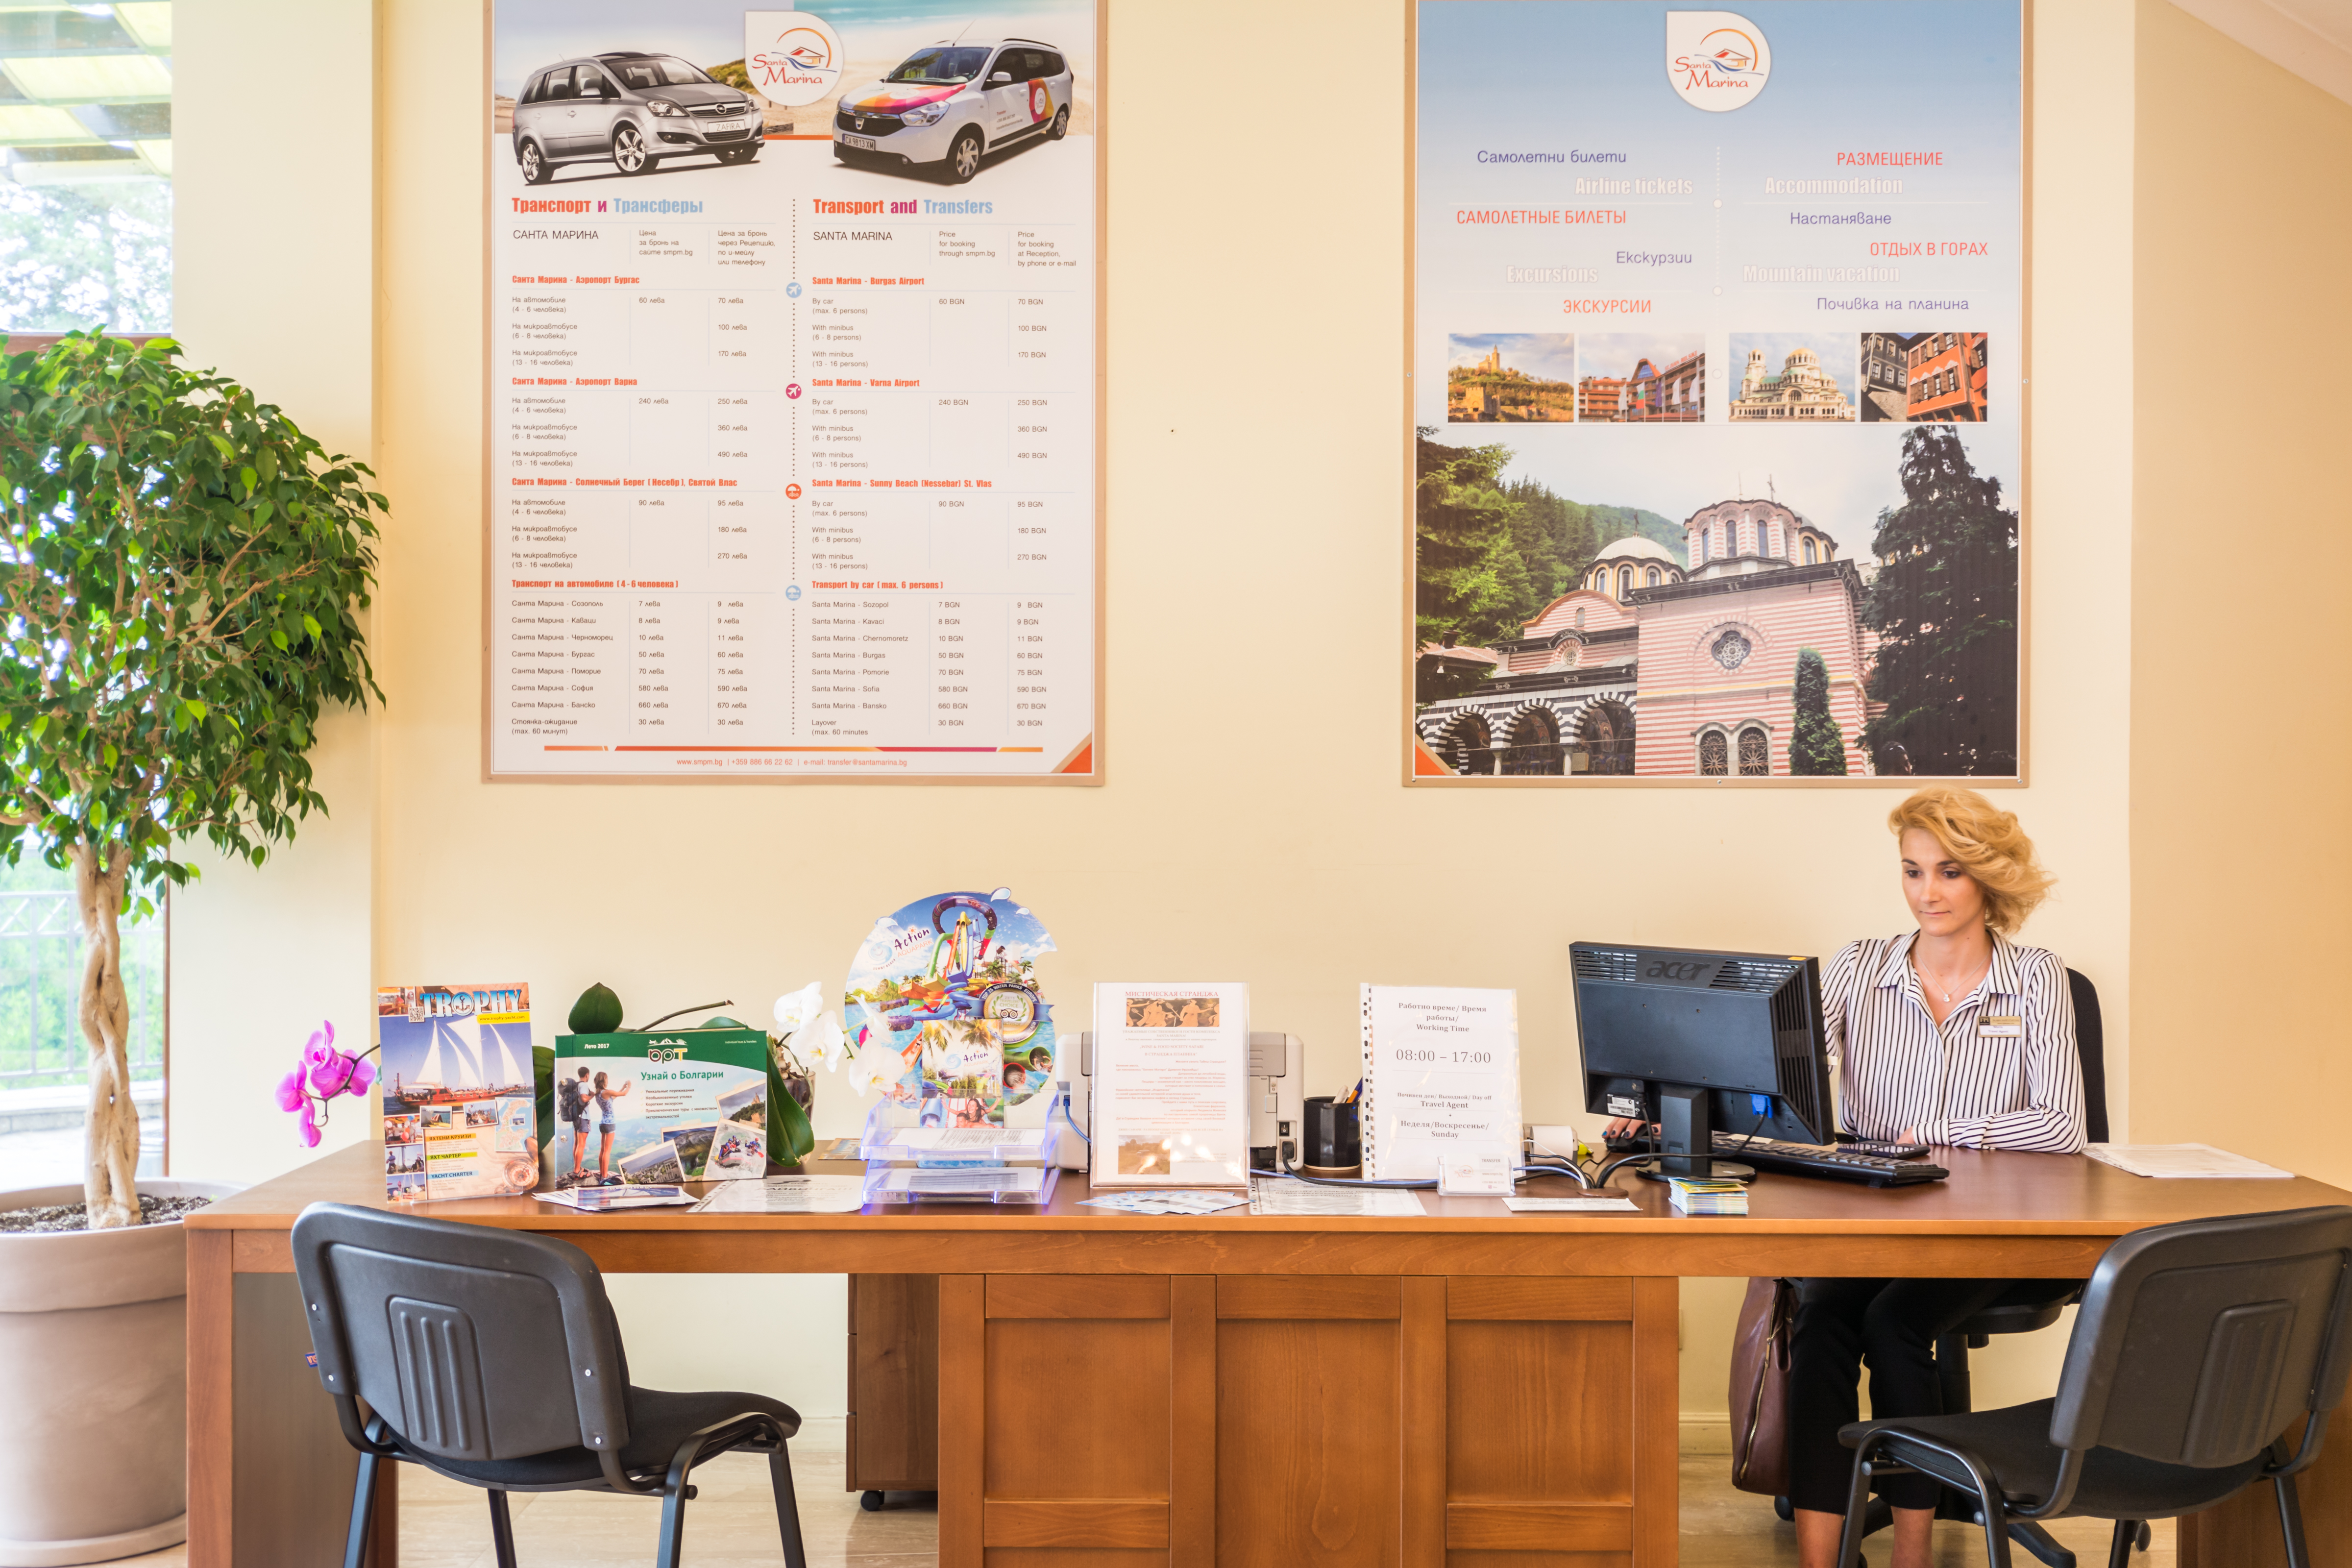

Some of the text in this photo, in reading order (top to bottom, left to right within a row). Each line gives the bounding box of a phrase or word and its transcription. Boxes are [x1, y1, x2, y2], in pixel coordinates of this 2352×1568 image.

[752, 54, 787, 69] Santa
[1674, 57, 1711, 72] Santa
[763, 67, 823, 86] Marina
[1686, 70, 1748, 90] Marina
[716, 122, 741, 132] ZAFIRA
[853, 138, 865, 147] 9813
[1477, 149, 1626, 163] Самолетни билети
[1837, 152, 1943, 168] РАЗМЕЩЕНИЕ
[1575, 177, 1692, 195] Airline tickets
[1765, 176, 1902, 195] Accommodation
[512, 197, 702, 214] Транспорт и Трансферы
[813, 199, 993, 215] Transport and Transfers
[1457, 210, 1626, 224] САМОЛЕТНЫЕ БИЛЕТЫ
[1790, 212, 1891, 225] Настаняване
[513, 229, 599, 240] САНТА МАРИНА
[813, 231, 893, 241] SANTA MARINA
[1870, 242, 1988, 258] ОТДЫХ В ГОРАХ
[1617, 251, 1692, 267] Екскурзии
[512, 275, 535, 283] Санта
[538, 275, 567, 284] Марина
[576, 276, 612, 284] Аэропорт
[614, 276, 640, 285] Бургас
[1506, 265, 1598, 283] Excursions
[1743, 264, 1900, 282] Mountain vacation
[812, 276, 833, 285] Santa
[836, 276, 862, 285] Marina
[870, 277, 897, 286] Burgas
[899, 277, 925, 286] Airport
[1563, 299, 1651, 314] ЭКСКУРСИИ
[1817, 297, 1969, 310] Почивка на планина
[511, 718, 578, 726] Стоянка-ожидание
[676, 759, 723, 767] www.smpm.bg
[827, 759, 907, 767] transfer@santamarina.bg
[894, 927, 930, 951] Action
[898, 939, 933, 958] AQUAPARK
[1645, 960, 1712, 981] acer
[1024, 988, 1037, 1003] EUROPE
[420, 989, 522, 1018] TROPHY
[1426, 1014, 1459, 1023] работы/
[1416, 1024, 1448, 1032] Working
[963, 1050, 988, 1062] Action
[1396, 1049, 1435, 1061] 08:00
[1452, 1052, 1491, 1063] 17:00
[640, 1071, 668, 1081] Узнай
[680, 1070, 724, 1081] Болгарии
